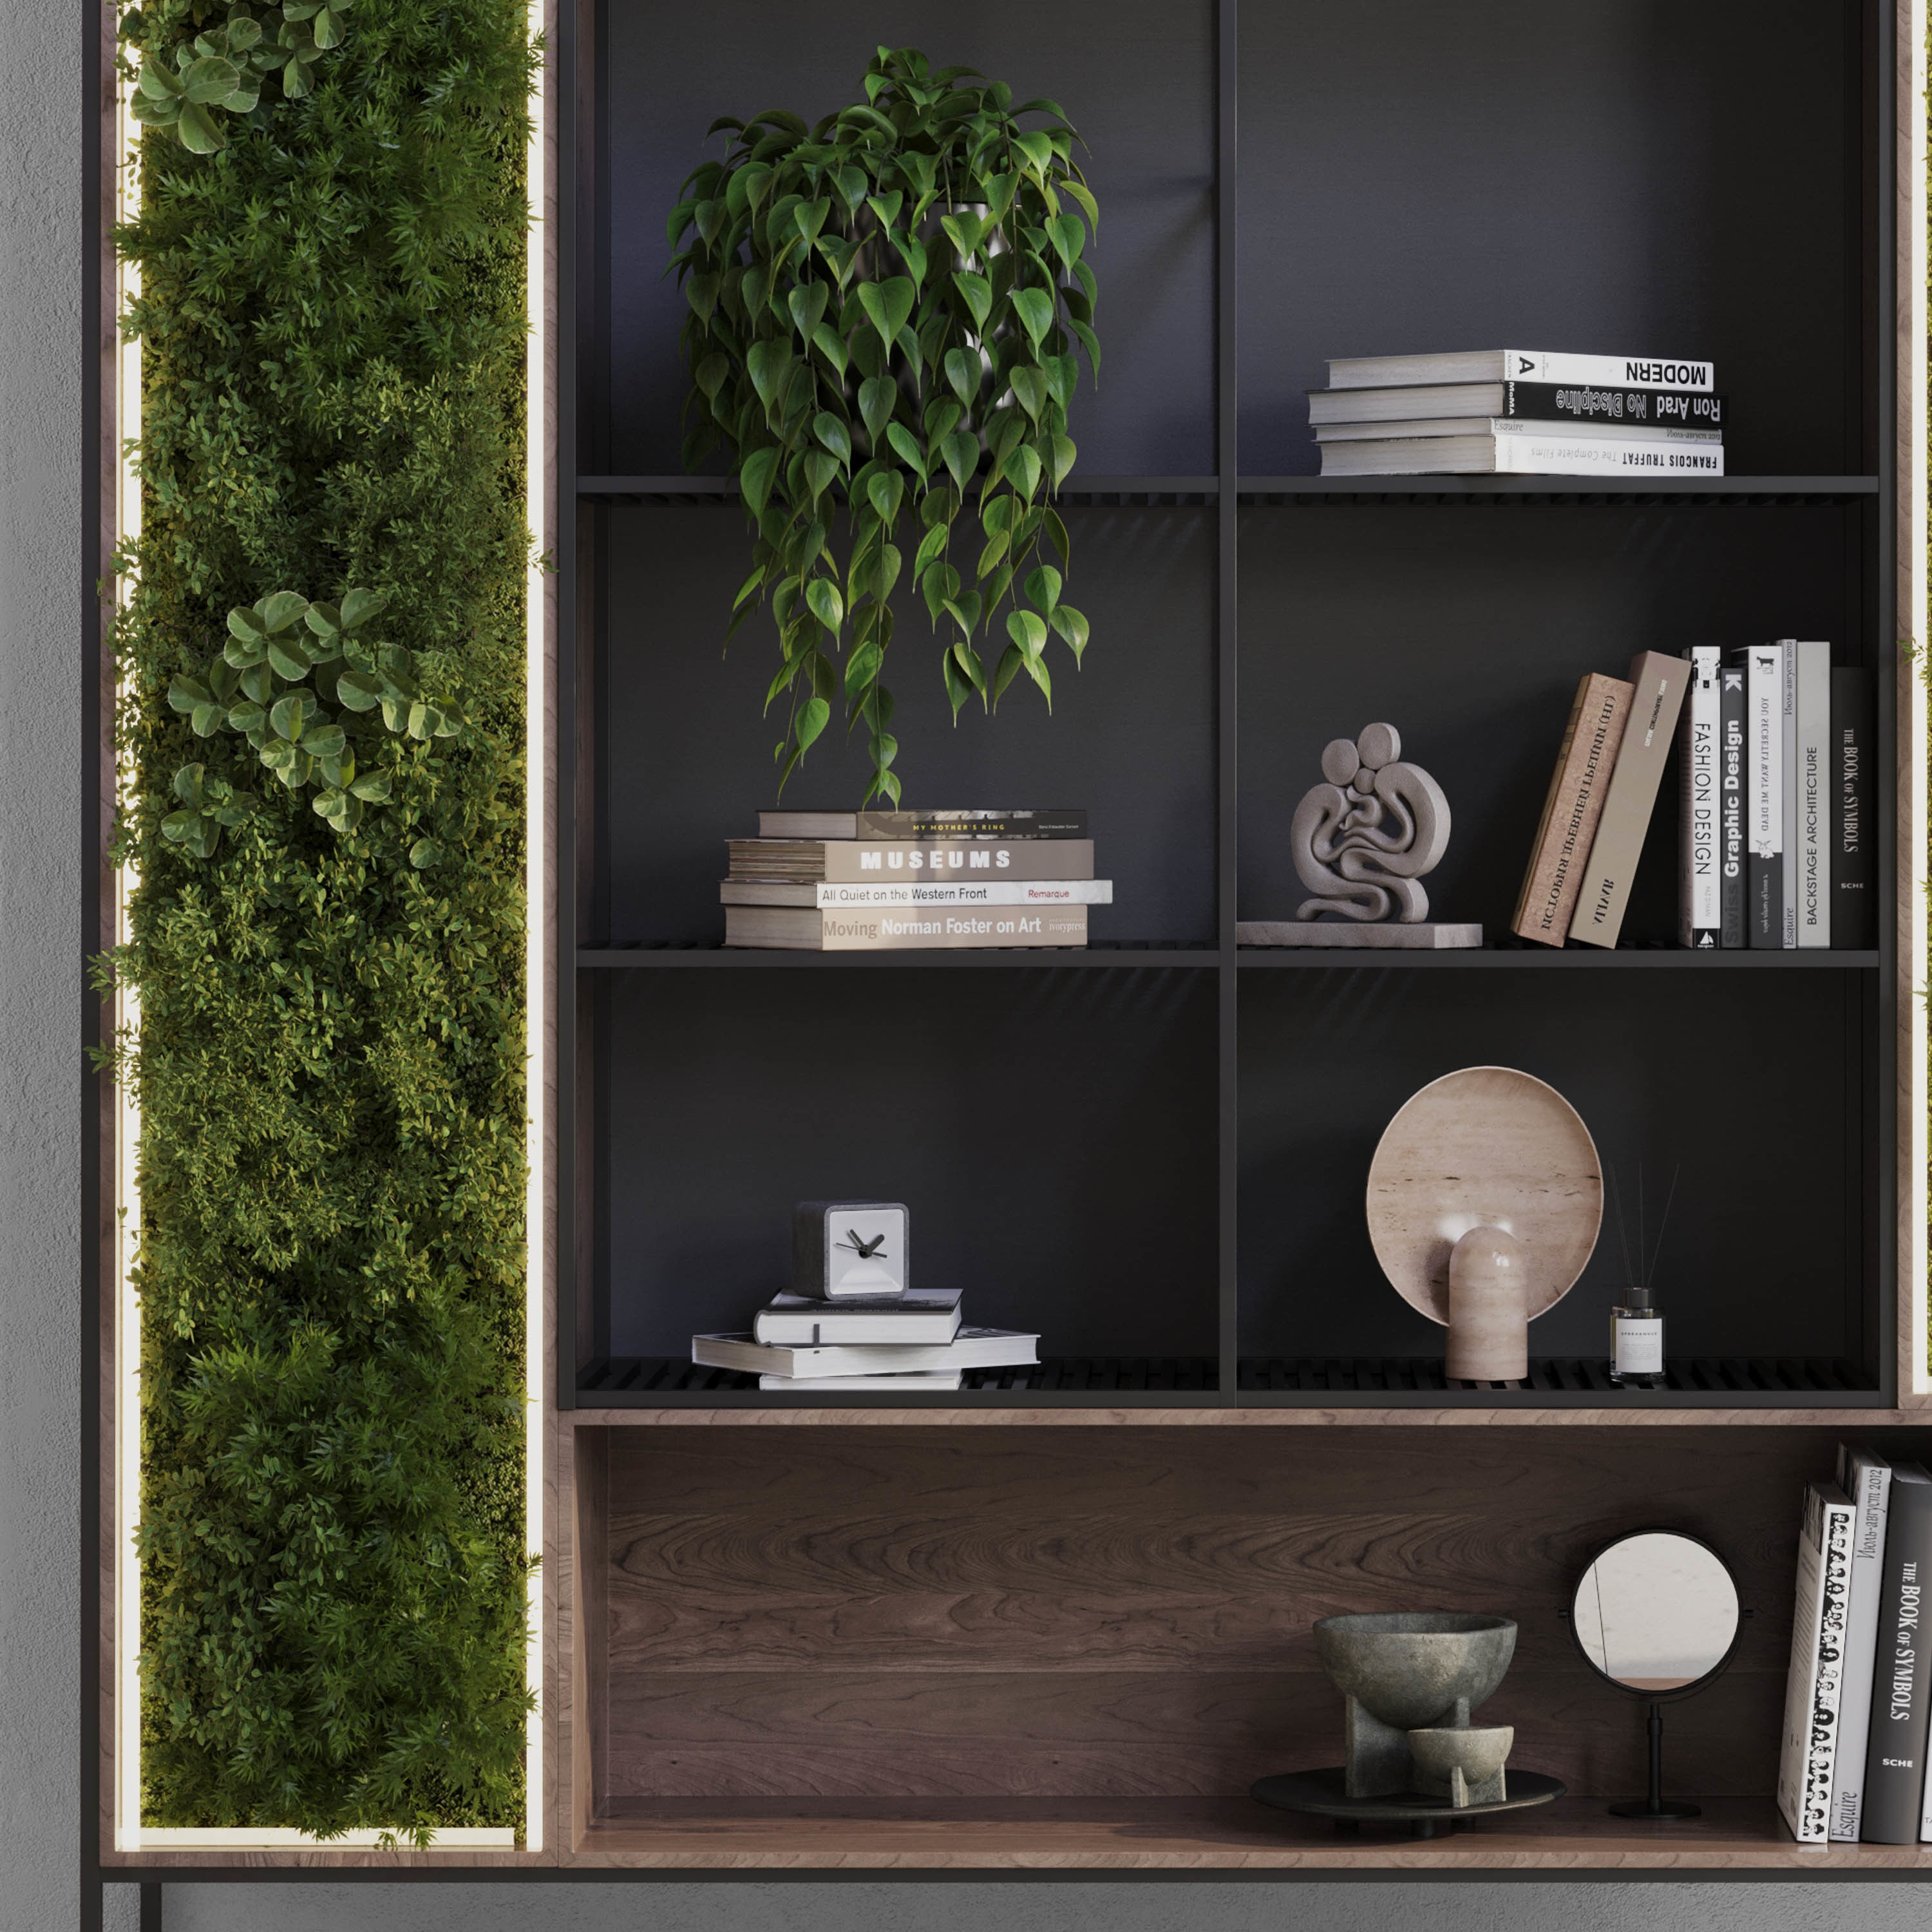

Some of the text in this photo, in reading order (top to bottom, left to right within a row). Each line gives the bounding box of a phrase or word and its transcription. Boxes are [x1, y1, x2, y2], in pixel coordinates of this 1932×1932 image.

[1519, 357, 1535, 374] A
[1626, 362, 1706, 385] MODERN
[1556, 386, 1720, 422] Ron Arad No Discipline
[1494, 419, 1524, 432] Esquire
[1531, 448, 1717, 469] FRANCOIS TRUFFAT The Complete Films
[1725, 674, 1742, 692] K
[1694, 723, 1711, 875] FASHION DESIGN
[1844, 728, 1859, 853] THE BOOK OF SYMBOLS
[1724, 720, 1743, 943] Swiss Graphic Design
[1806, 746, 1817, 925] BACKSTAGE ARCHITECTURE
[860, 850, 1010, 869] MUSEUMS
[822, 888, 987, 900] All Quiet on the Western Front
[1028, 889, 1070, 899] Remarque
[824, 917, 1041, 939] Moving Norman Foster on Art
[1785, 907, 1795, 946] Esquire
[1857, 1469, 1886, 1559] Июль-август 2012
[1890, 1562, 1920, 1720] THE BOOK OF SYMBOLS
[1882, 1758, 1913, 1768] SCHE
[1831, 1792, 1859, 1837] Esquire
